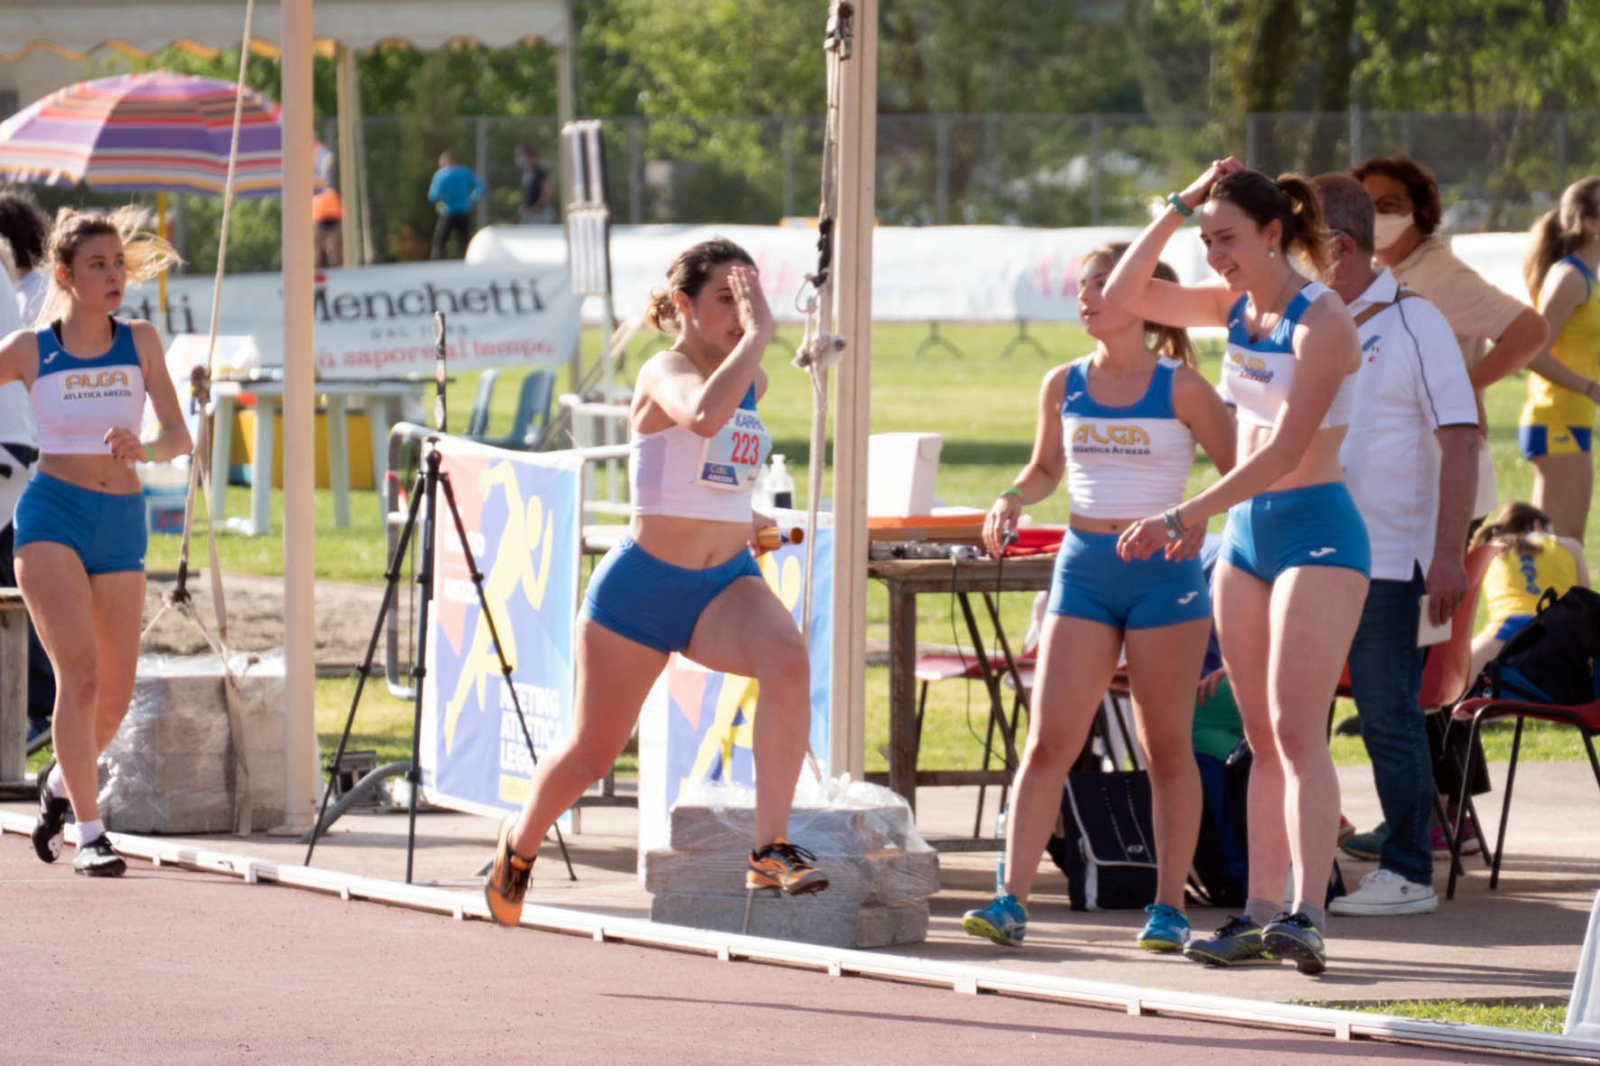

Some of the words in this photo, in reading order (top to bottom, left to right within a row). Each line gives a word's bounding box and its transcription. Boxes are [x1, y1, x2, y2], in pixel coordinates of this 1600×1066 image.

[63, 390, 101, 401] ATLETICA
[103, 389, 132, 398] AREZZO
[731, 431, 759, 465] 223
